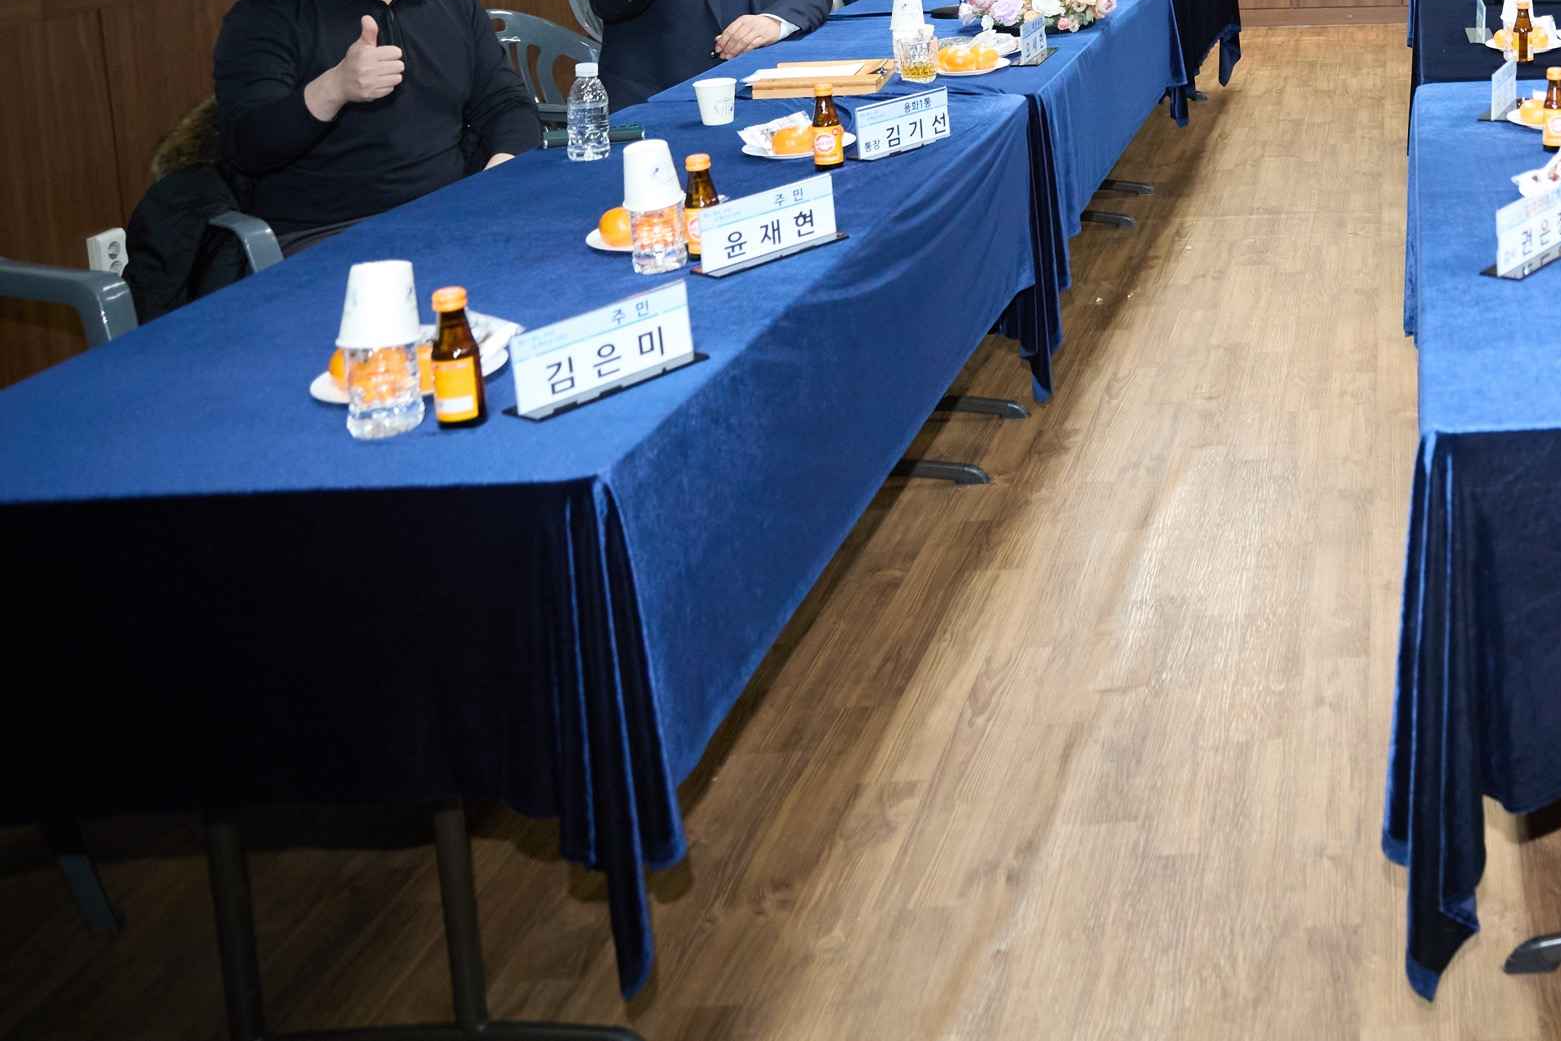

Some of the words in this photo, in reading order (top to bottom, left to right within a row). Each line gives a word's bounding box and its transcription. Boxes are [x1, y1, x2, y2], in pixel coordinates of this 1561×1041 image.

[886, 112, 946, 148] 김기선
[775, 188, 804, 207] 주민
[724, 208, 815, 259] 윤재현
[612, 300, 649, 325] 주민
[546, 325, 664, 395] 김은미
